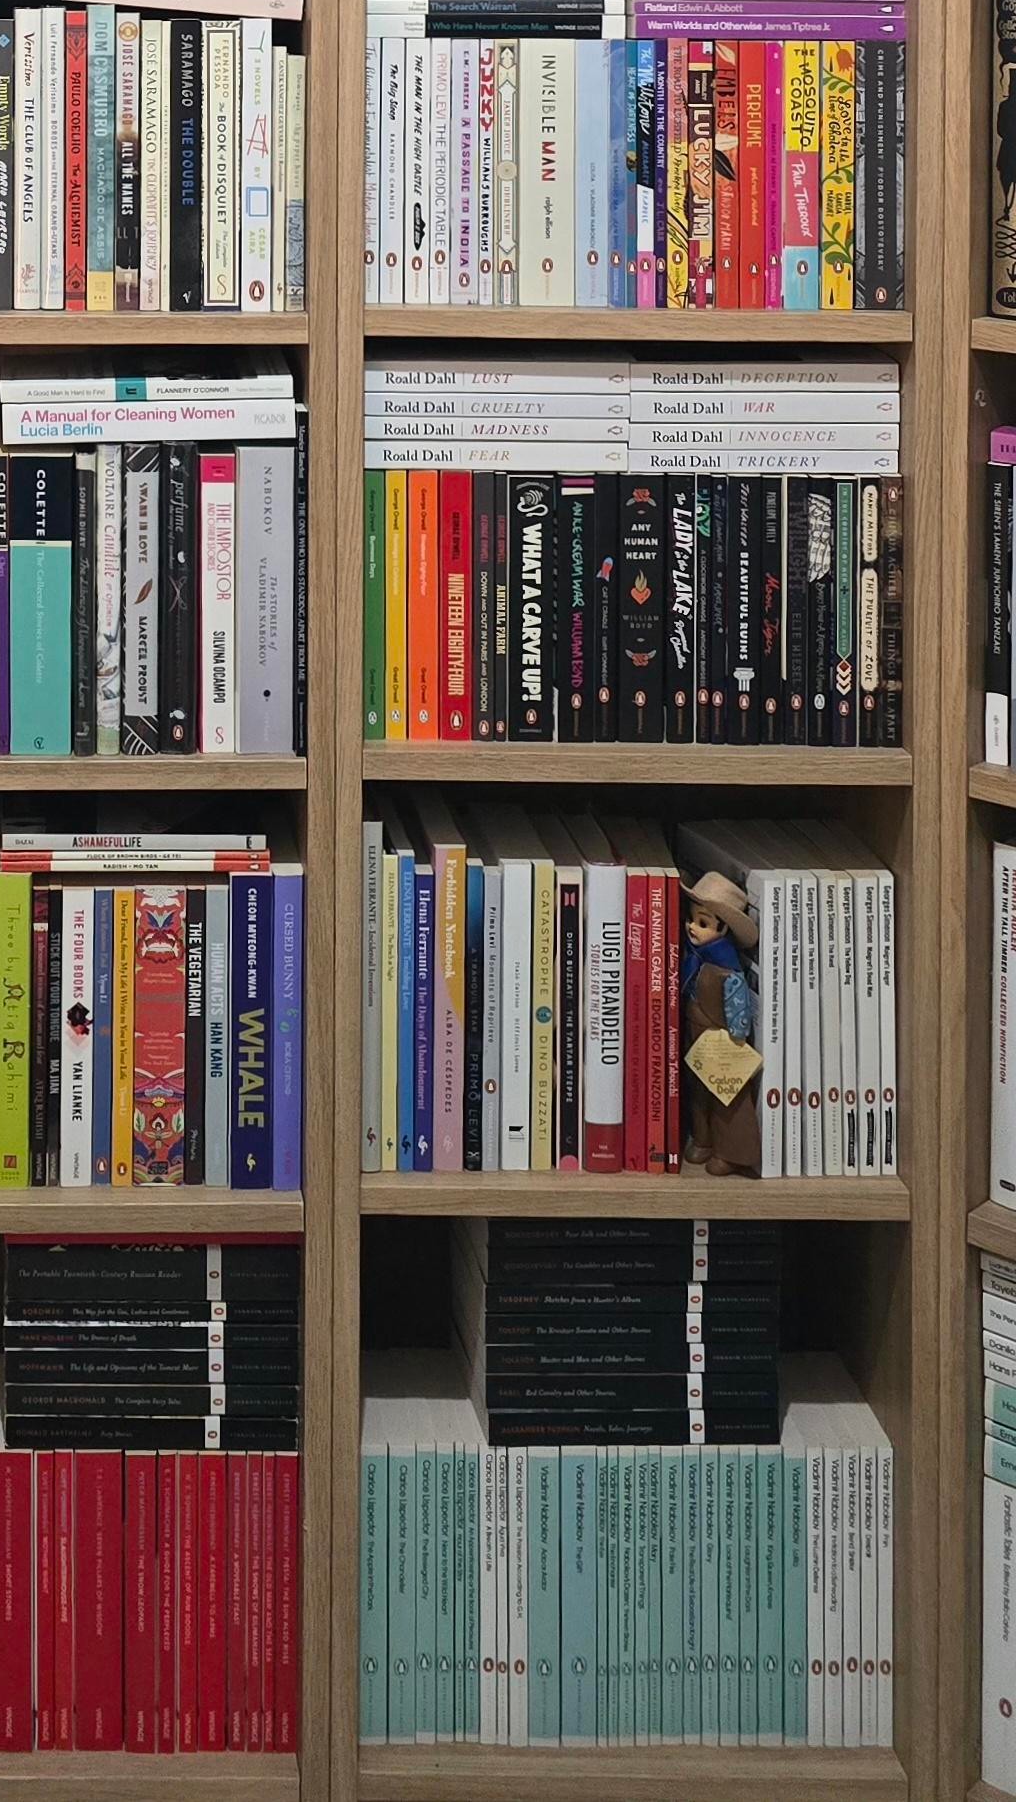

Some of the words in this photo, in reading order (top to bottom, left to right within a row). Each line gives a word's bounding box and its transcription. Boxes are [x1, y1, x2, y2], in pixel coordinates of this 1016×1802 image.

[541, 55, 555, 134] INVISIBLE
[747, 84, 762, 148] PERFUME
[790, 78, 802, 132] COAST
[799, 62, 817, 147] MOSQUITO
[541, 142, 555, 182] MAN
[691, 105, 711, 185] LUCKY
[692, 196, 711, 238] JIM
[385, 372, 419, 385] Roald
[424, 372, 456, 385] Dahl
[471, 373, 513, 385] LUST
[20, 424, 59, 438] Lucia
[62, 423, 103, 437] Berlin
[35, 408, 87, 422] Manual
[91, 408, 111, 420] for
[114, 407, 177, 423] Cleaning
[180, 407, 235, 420] Women
[521, 523, 541, 584] WHAT
[521, 586, 541, 599] A
[521, 603, 541, 665] CARVE
[521, 668, 541, 702] UP!
[603, 922, 619, 961] LUIGI
[1001, 917, 1009, 937] TALL
[603, 966, 619, 1066] PIRANDELLO
[237, 1008, 265, 1128] WHALE
[999, 1030, 1007, 1085] NONFICTION
